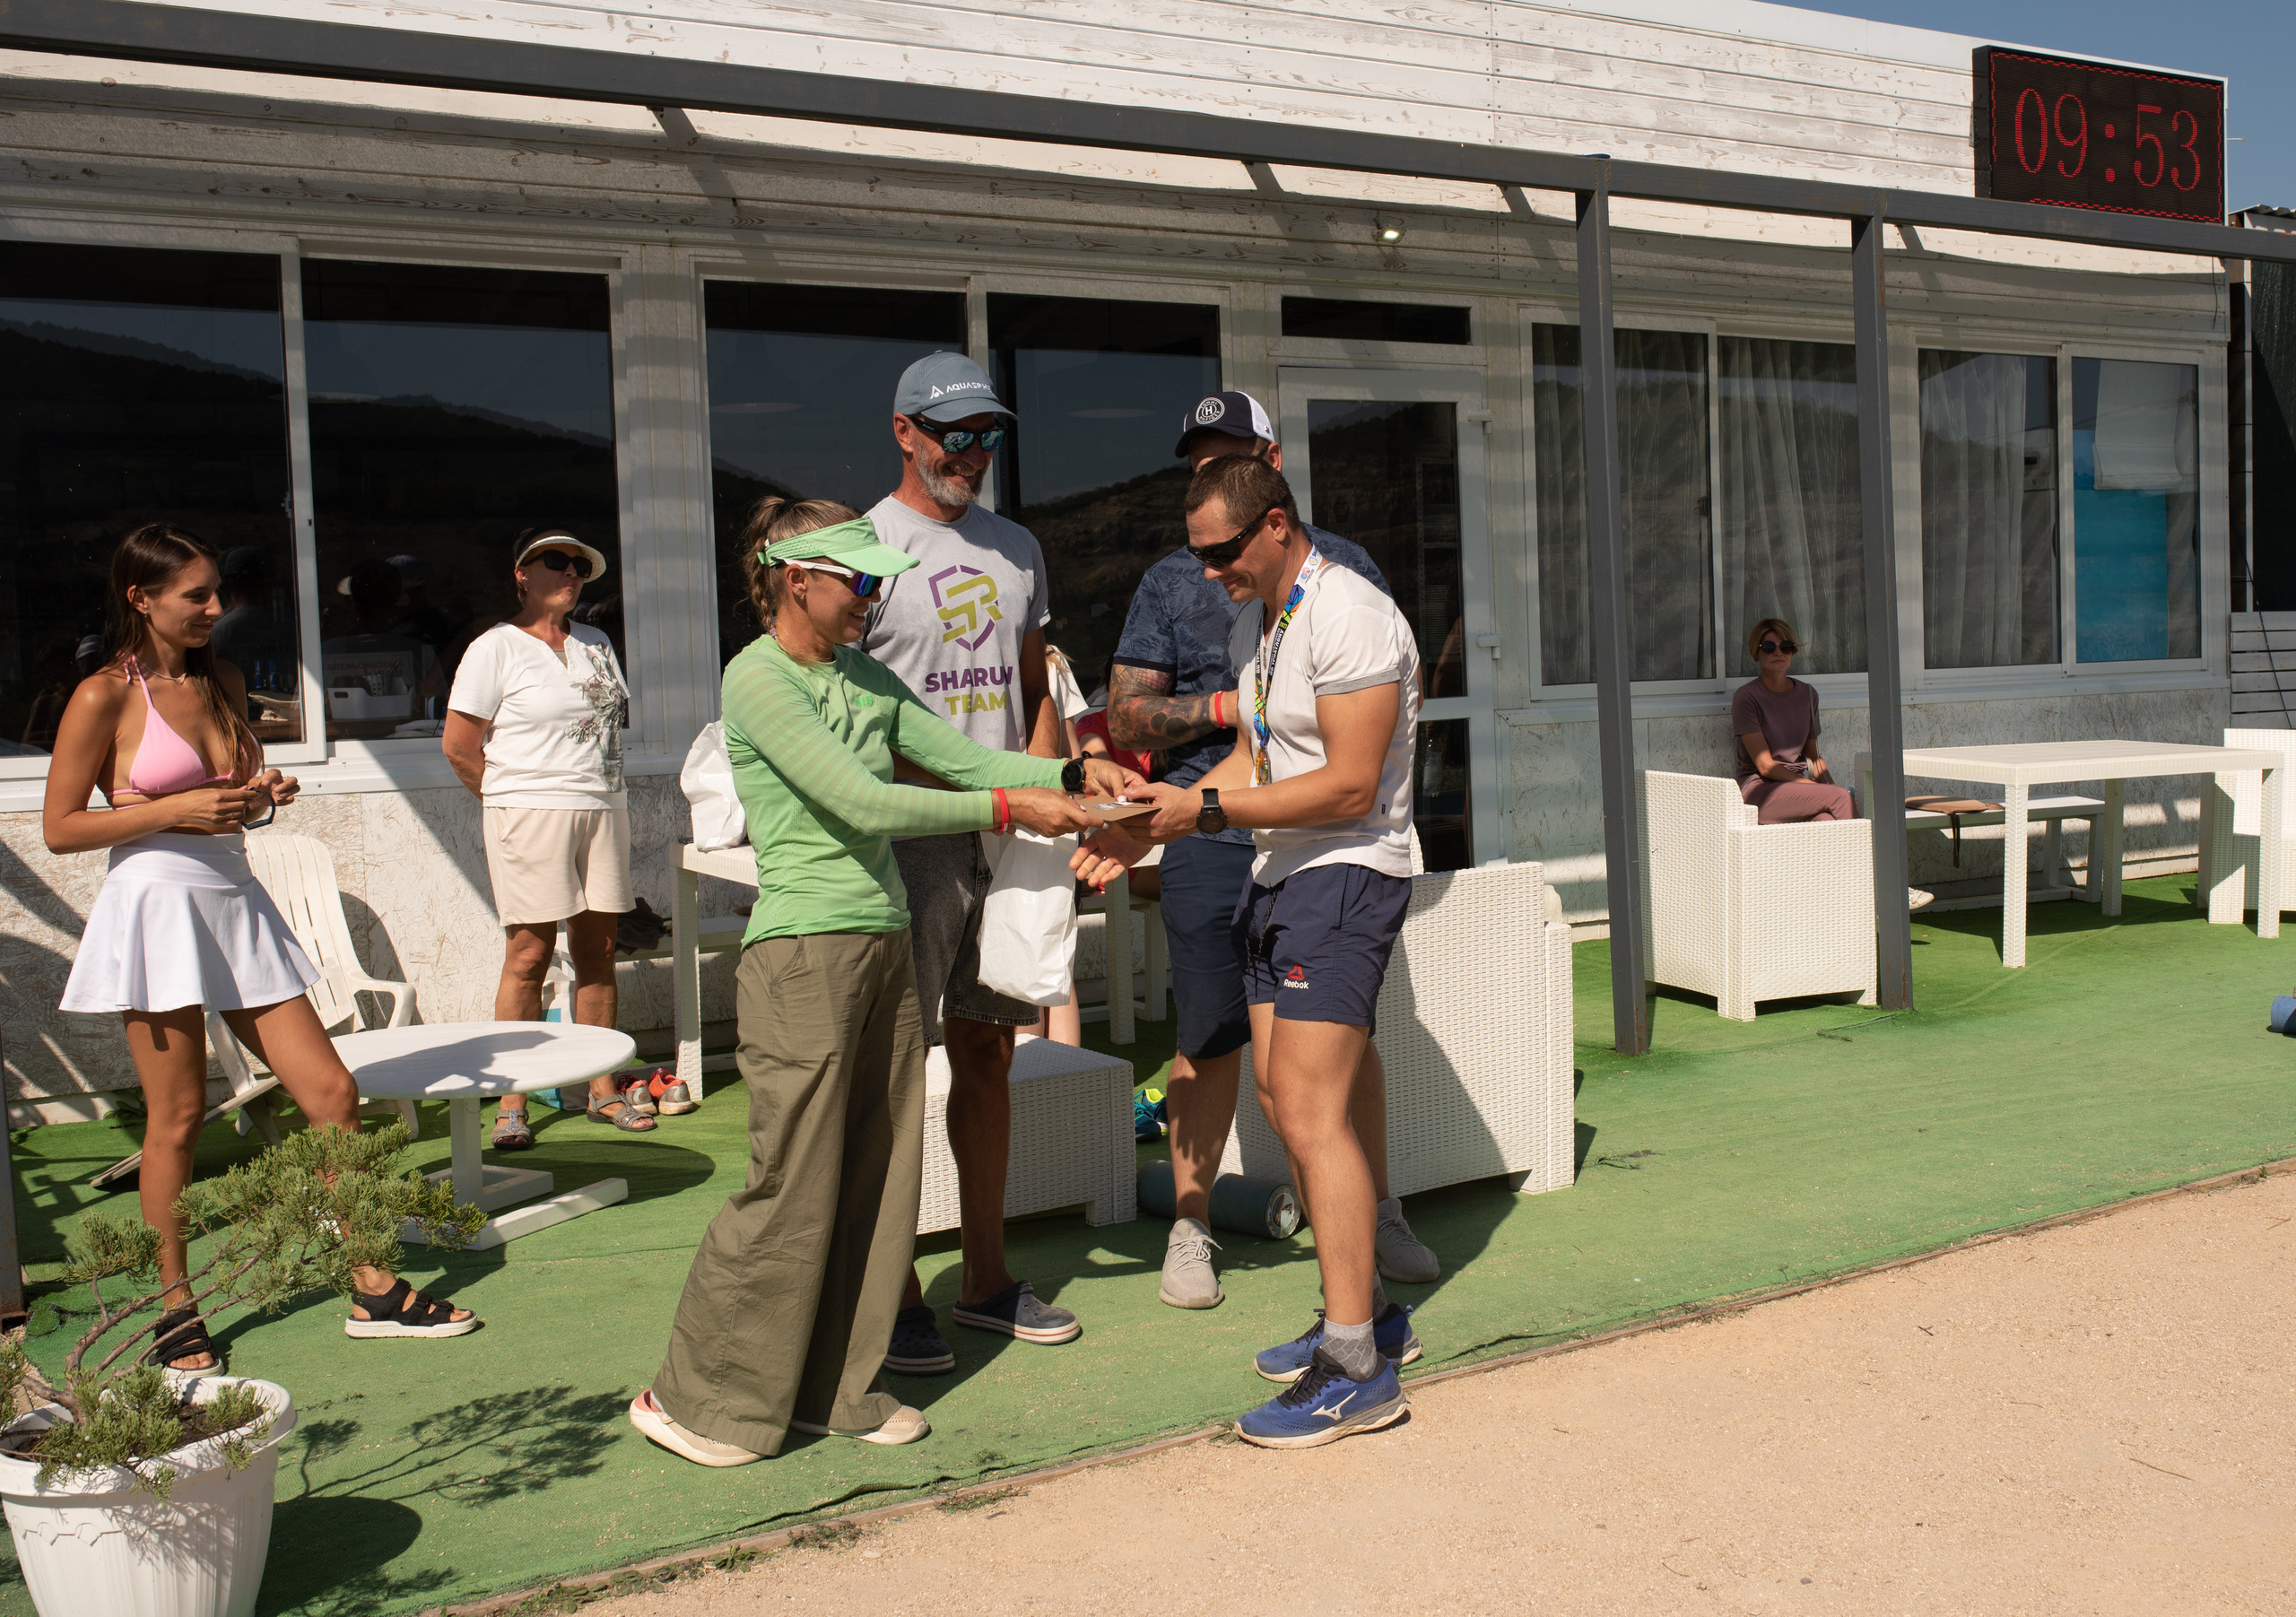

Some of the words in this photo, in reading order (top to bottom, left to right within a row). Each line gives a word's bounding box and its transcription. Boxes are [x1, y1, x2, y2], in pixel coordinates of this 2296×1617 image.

[2015, 88, 2201, 191] 09:53
[946, 381, 995, 396] AQUASPHE
[944, 691, 1007, 716] TEAM
[1283, 978, 1309, 989] Reebok
